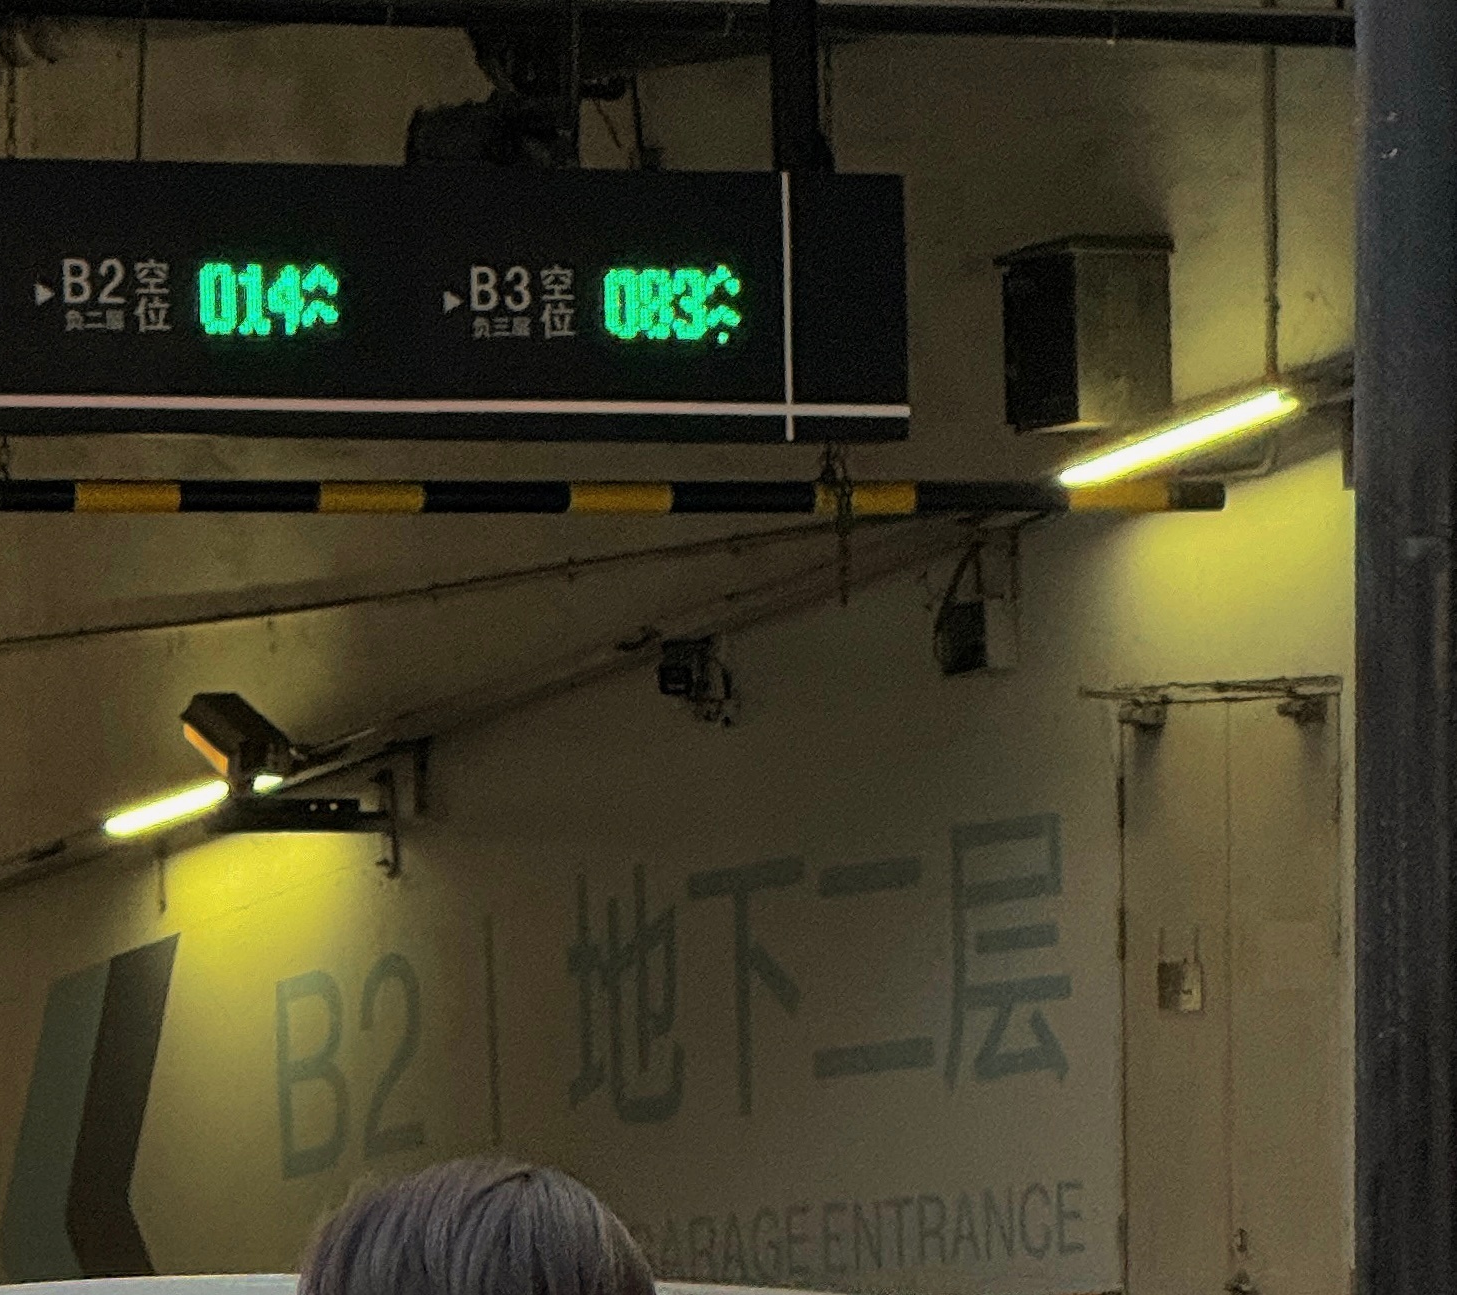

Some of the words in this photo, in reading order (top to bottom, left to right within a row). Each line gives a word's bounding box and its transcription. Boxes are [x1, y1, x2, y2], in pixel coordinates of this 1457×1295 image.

[62, 257, 126, 304] B2
[469, 265, 532, 312] B3
[566, 811, 1073, 1124] 地下二层
[274, 952, 429, 1180] B2
